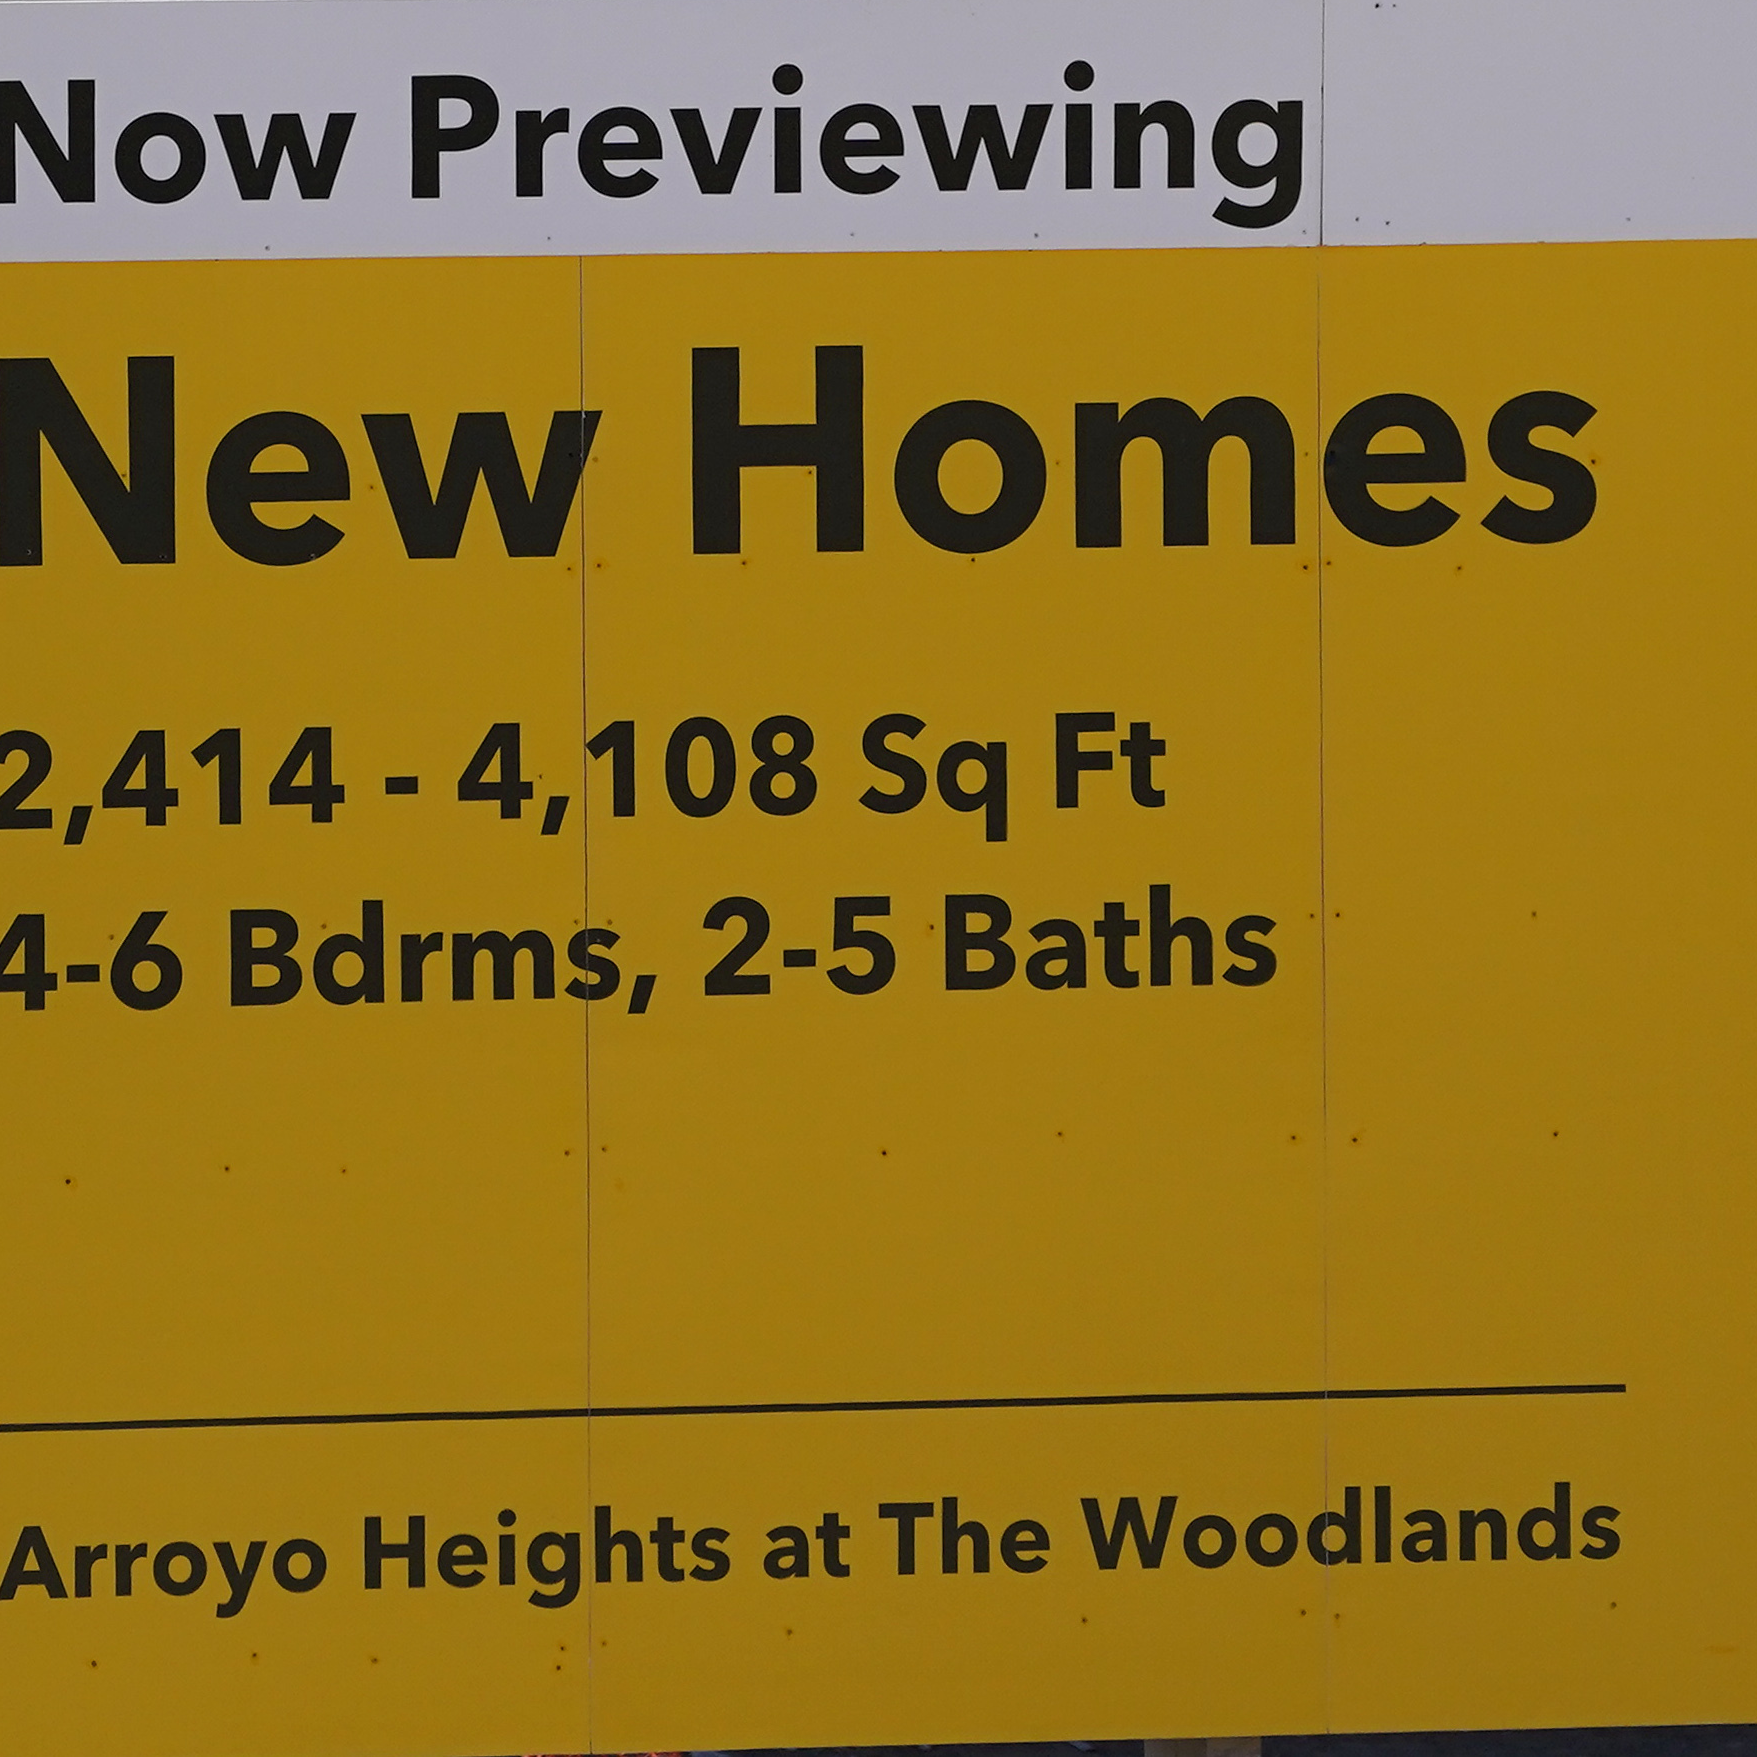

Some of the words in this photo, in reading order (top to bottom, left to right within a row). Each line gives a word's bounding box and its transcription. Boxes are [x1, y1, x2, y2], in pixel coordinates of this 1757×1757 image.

[412, 61, 1303, 228] Previewing
[692, 345, 1596, 554] Homes
[385, 777, 418, 794] -
[458, 715, 817, 835] 4,108
[861, 714, 1007, 842] Sq
[1056, 712, 1165, 808] Ft
[230, 900, 655, 1014] Bdrms,
[703, 896, 895, 995] 2-5
[945, 884, 1276, 990] Baths
[365, 1506, 730, 1608] Heights
[764, 1513, 850, 1579] at
[879, 1497, 1050, 1575] The
[1081, 1482, 1620, 1569] Woodlands
